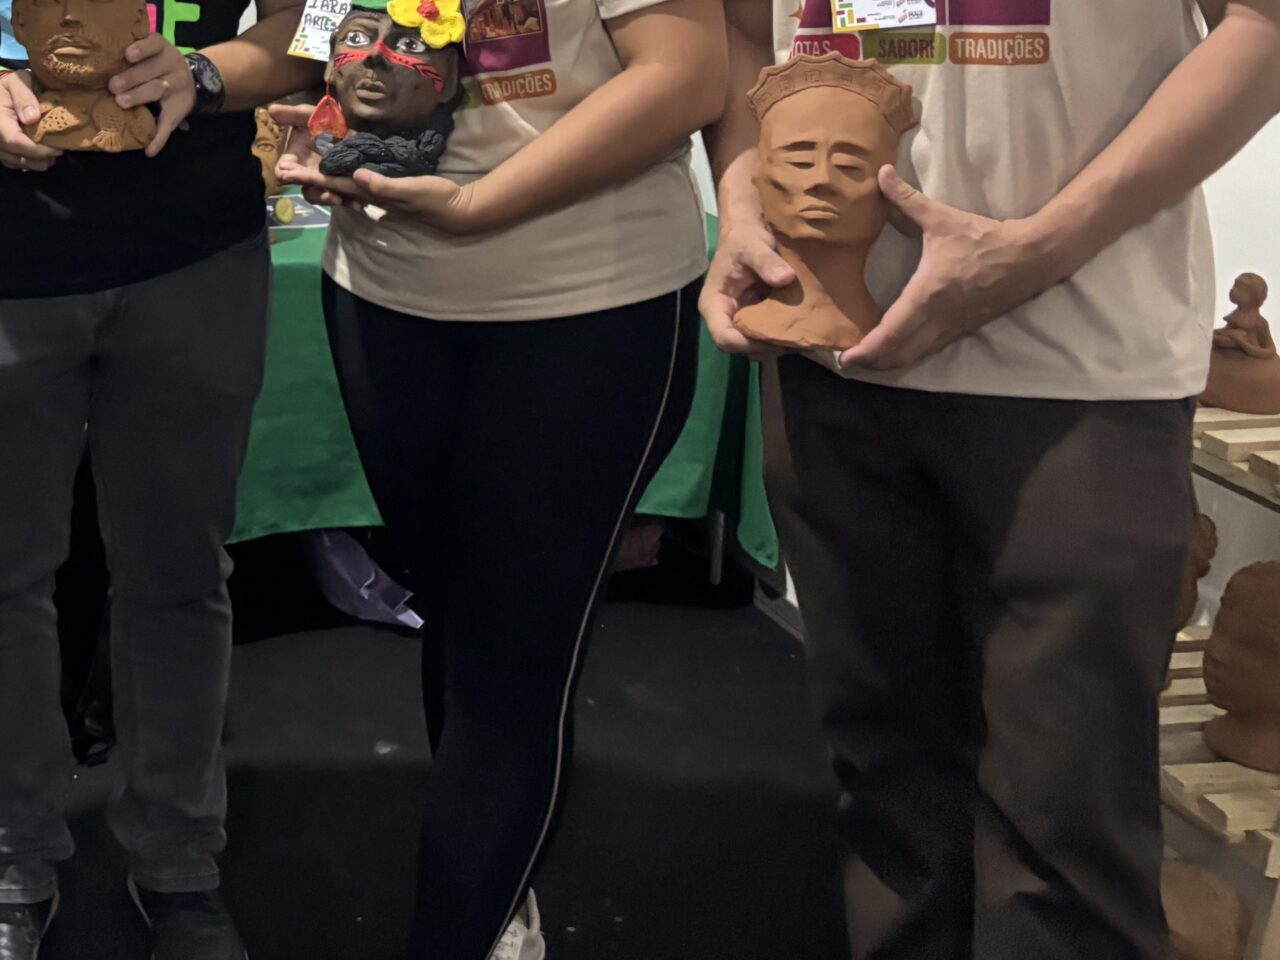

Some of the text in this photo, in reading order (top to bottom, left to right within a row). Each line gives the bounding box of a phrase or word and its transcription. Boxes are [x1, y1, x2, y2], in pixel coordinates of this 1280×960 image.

[304, 13, 338, 32] ARTES
[878, 40, 936, 59] SABORE
[955, 34, 1045, 65] TRADIÇÕES
